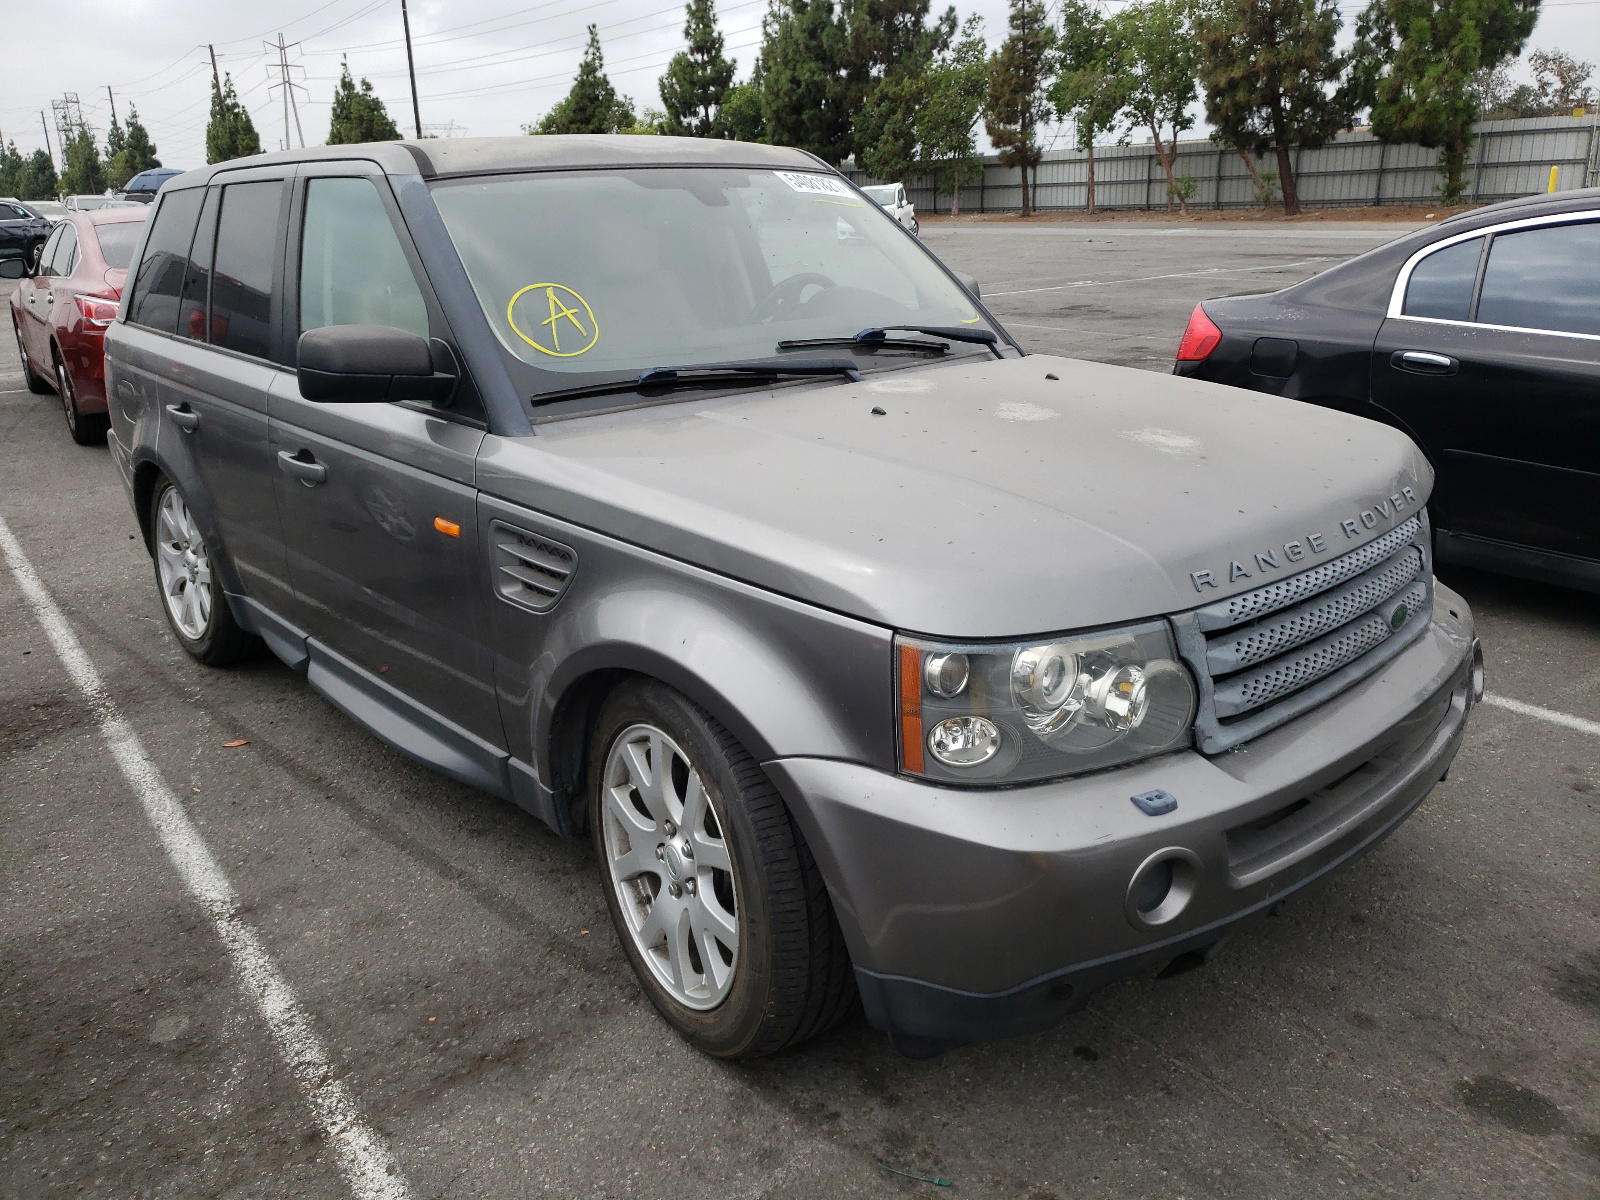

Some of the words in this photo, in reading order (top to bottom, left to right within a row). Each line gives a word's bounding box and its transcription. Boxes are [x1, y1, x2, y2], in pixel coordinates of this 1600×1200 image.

[541, 287, 587, 351] A
[1190, 532, 1328, 592] RANGE
[1341, 485, 1417, 538] ROVER
